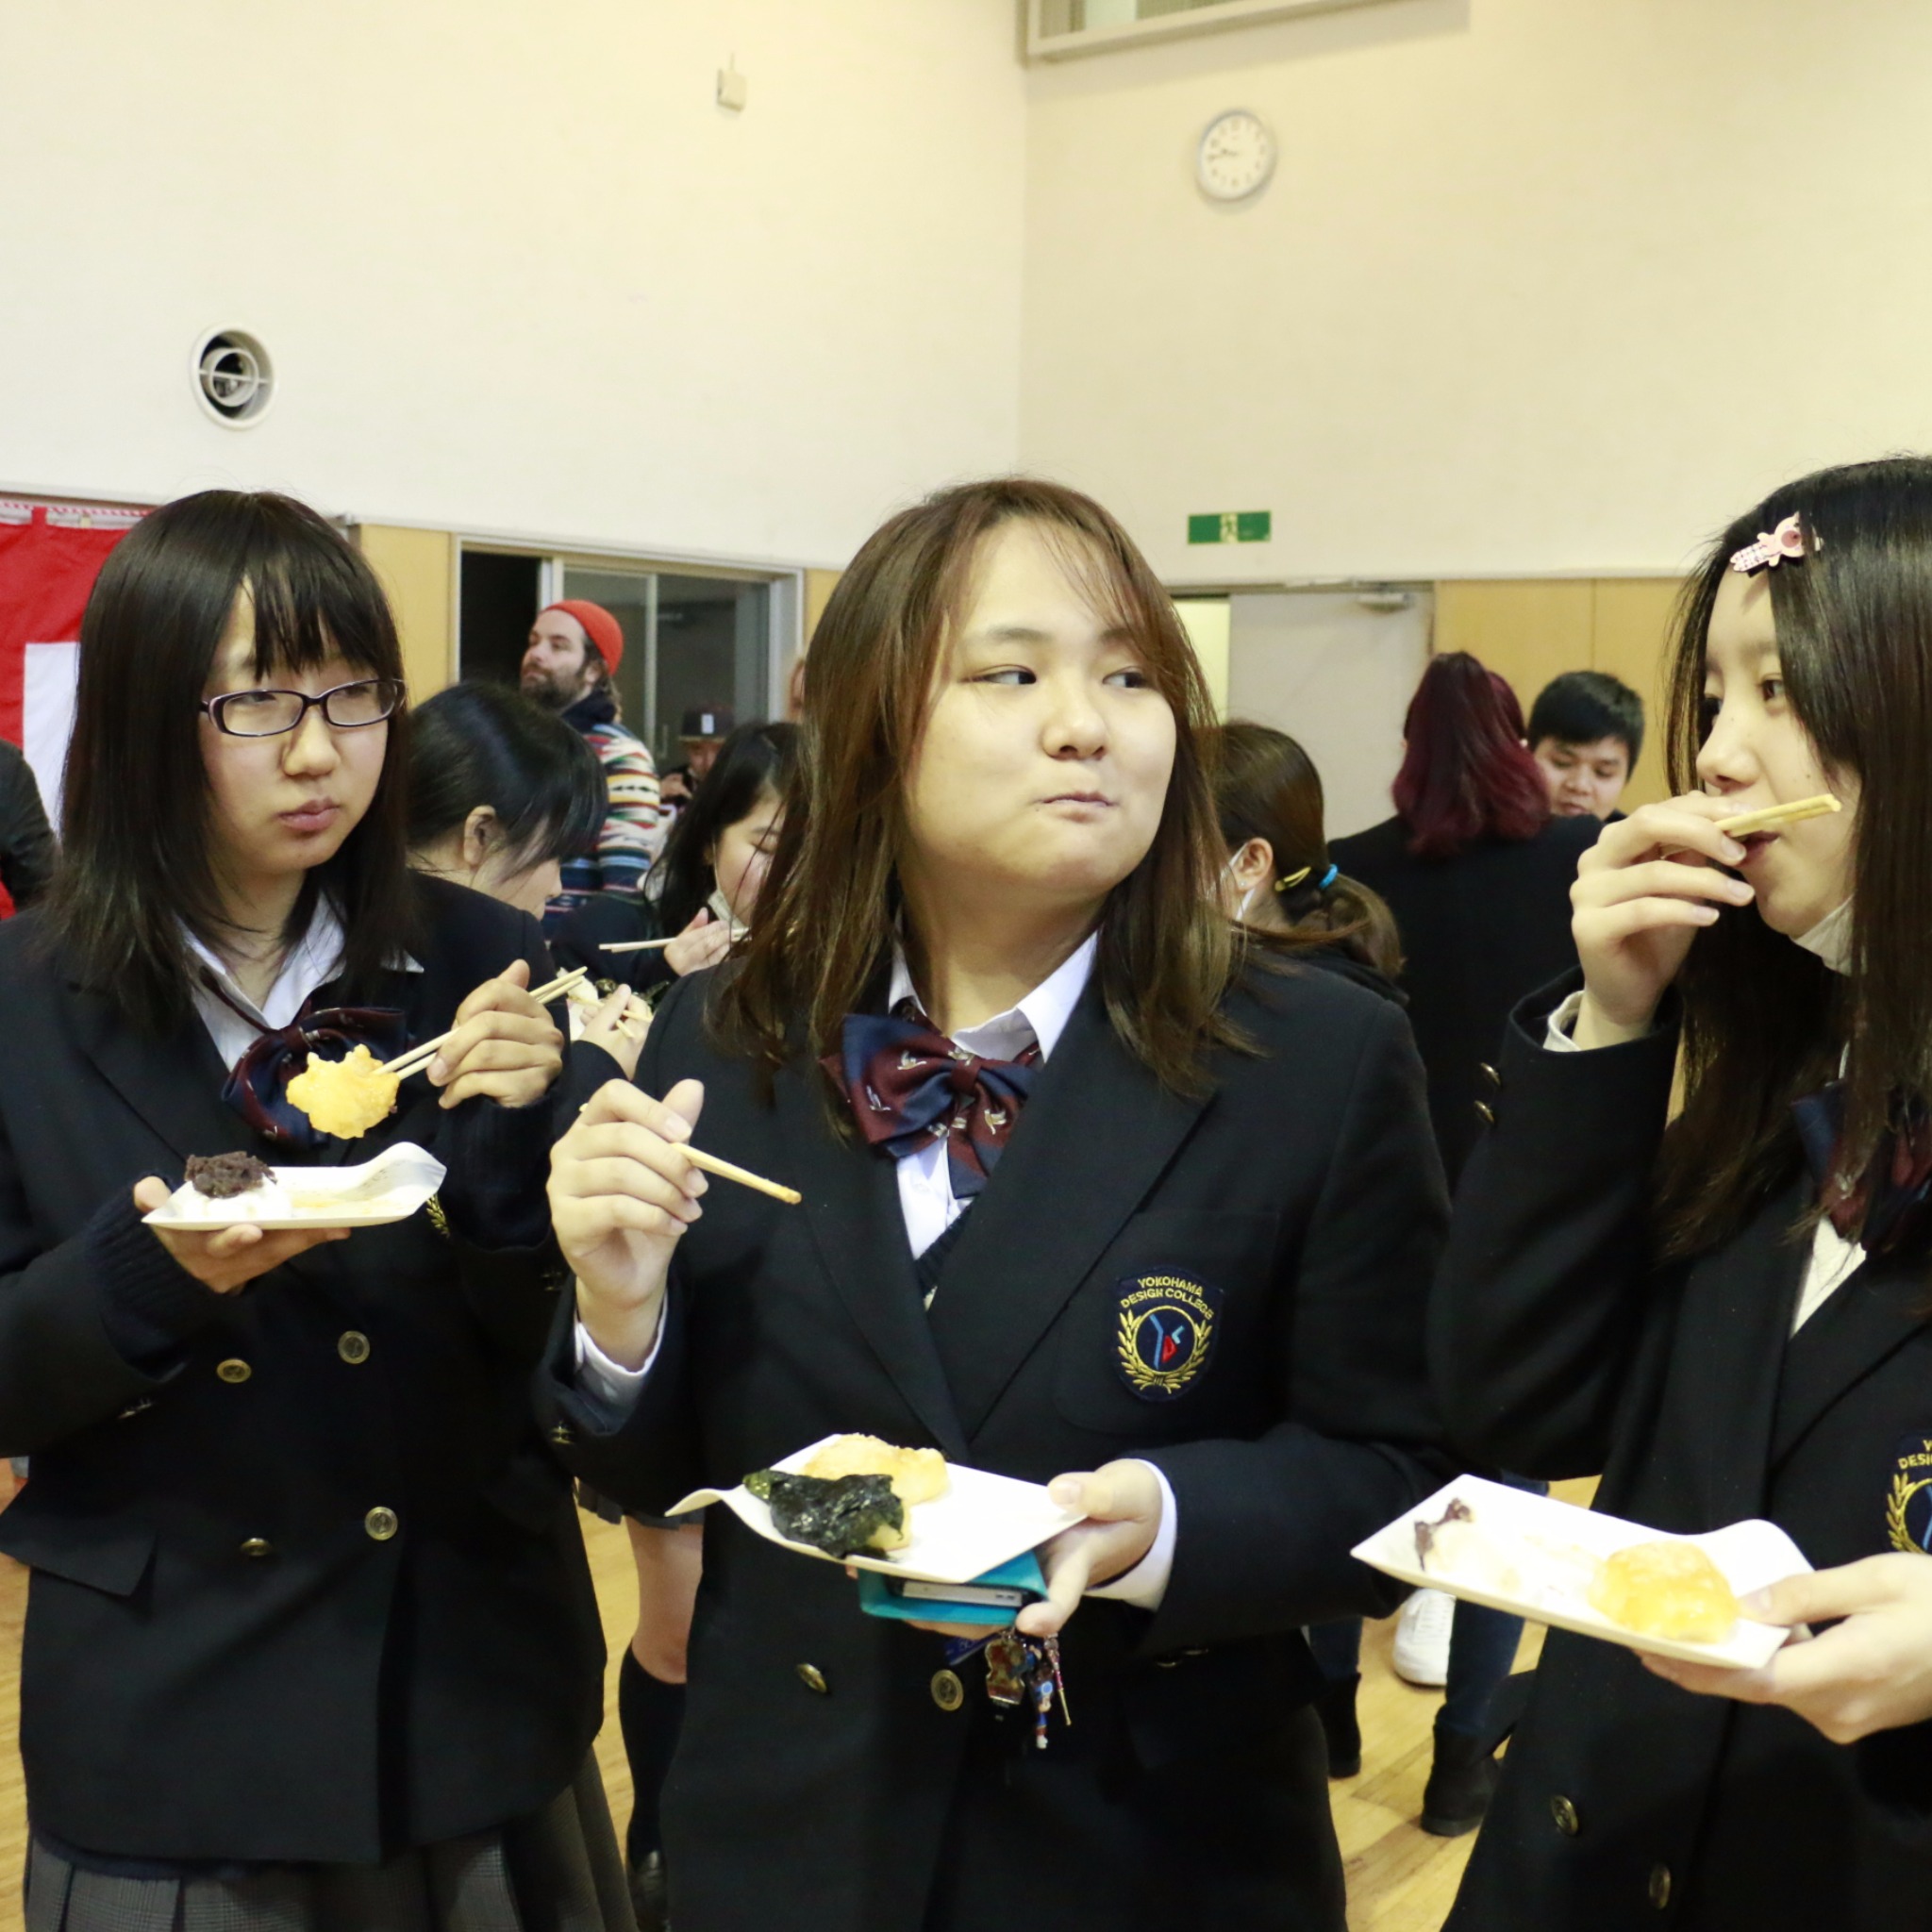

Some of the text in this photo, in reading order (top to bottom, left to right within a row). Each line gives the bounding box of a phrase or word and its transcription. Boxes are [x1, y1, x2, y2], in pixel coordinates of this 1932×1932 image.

[1138, 1276, 1203, 1297] YOKOHAMA
[1121, 1288, 1214, 1320] DESIGN COLLEGE
[1897, 1453, 1932, 1470] DESI
